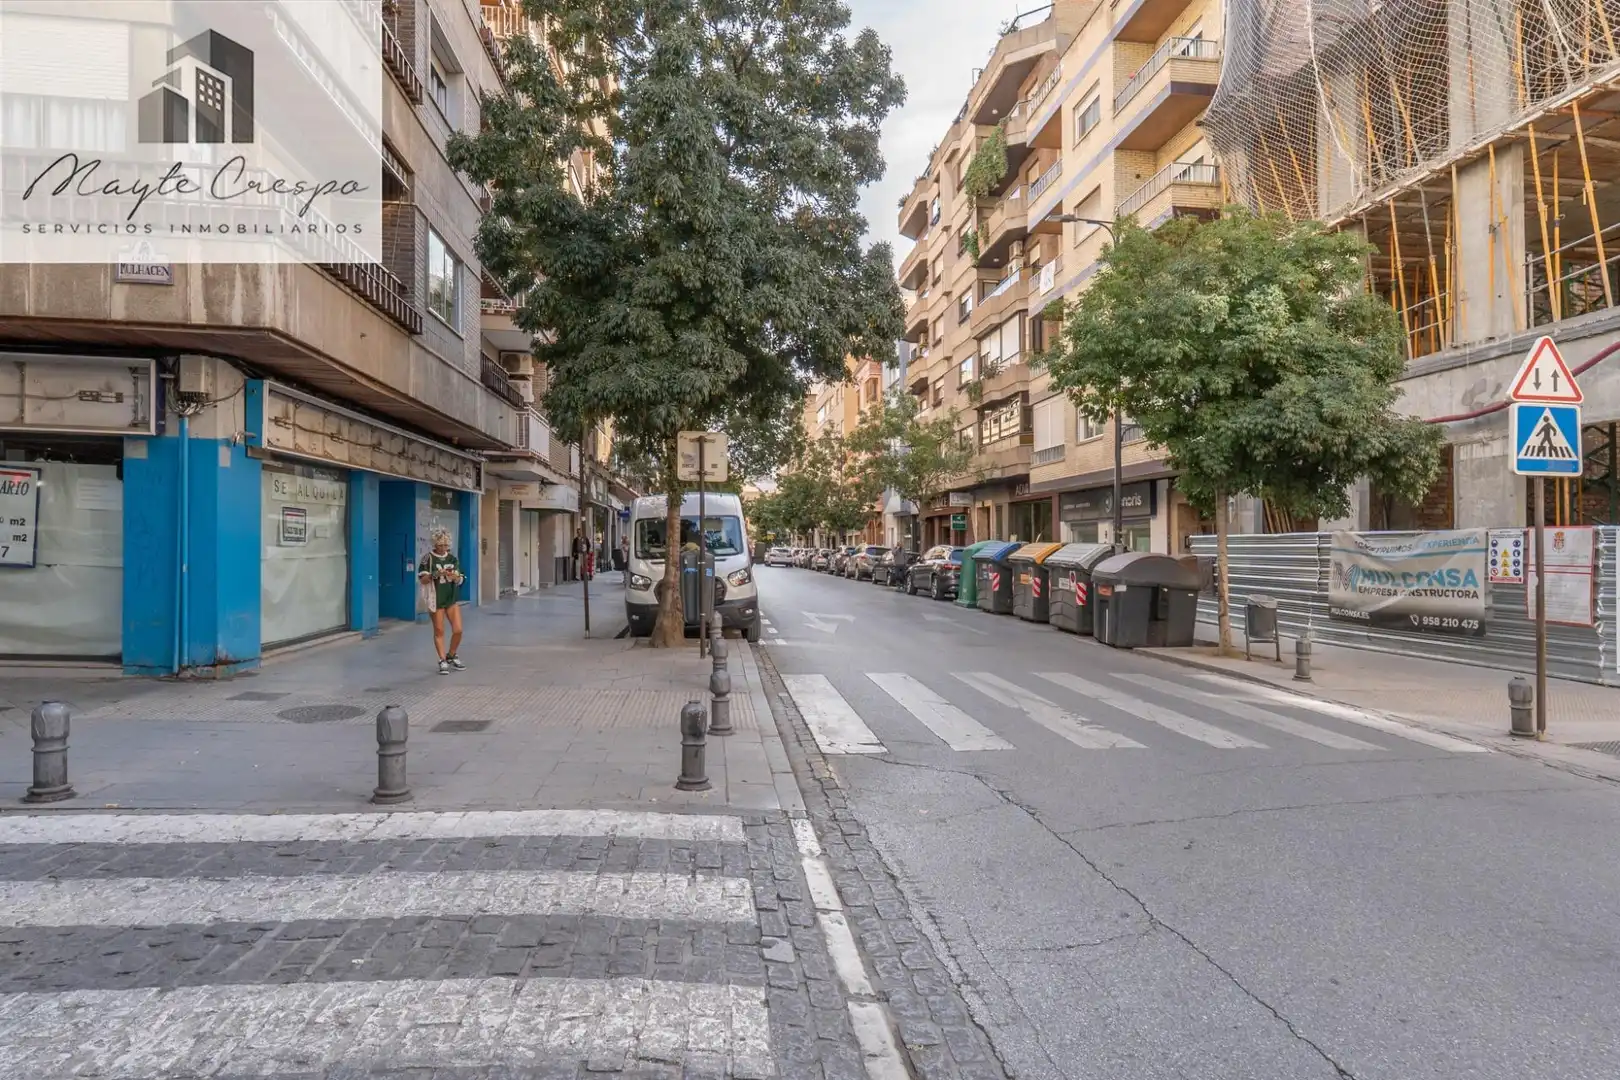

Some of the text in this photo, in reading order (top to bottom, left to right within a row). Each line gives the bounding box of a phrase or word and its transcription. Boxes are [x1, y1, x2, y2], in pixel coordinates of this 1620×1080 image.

[274, 479, 288, 495] SE
[1358, 586, 1480, 600] EMPRESA NSTRUCTORA
[1422, 616, 1479, 630] 958 210 475
